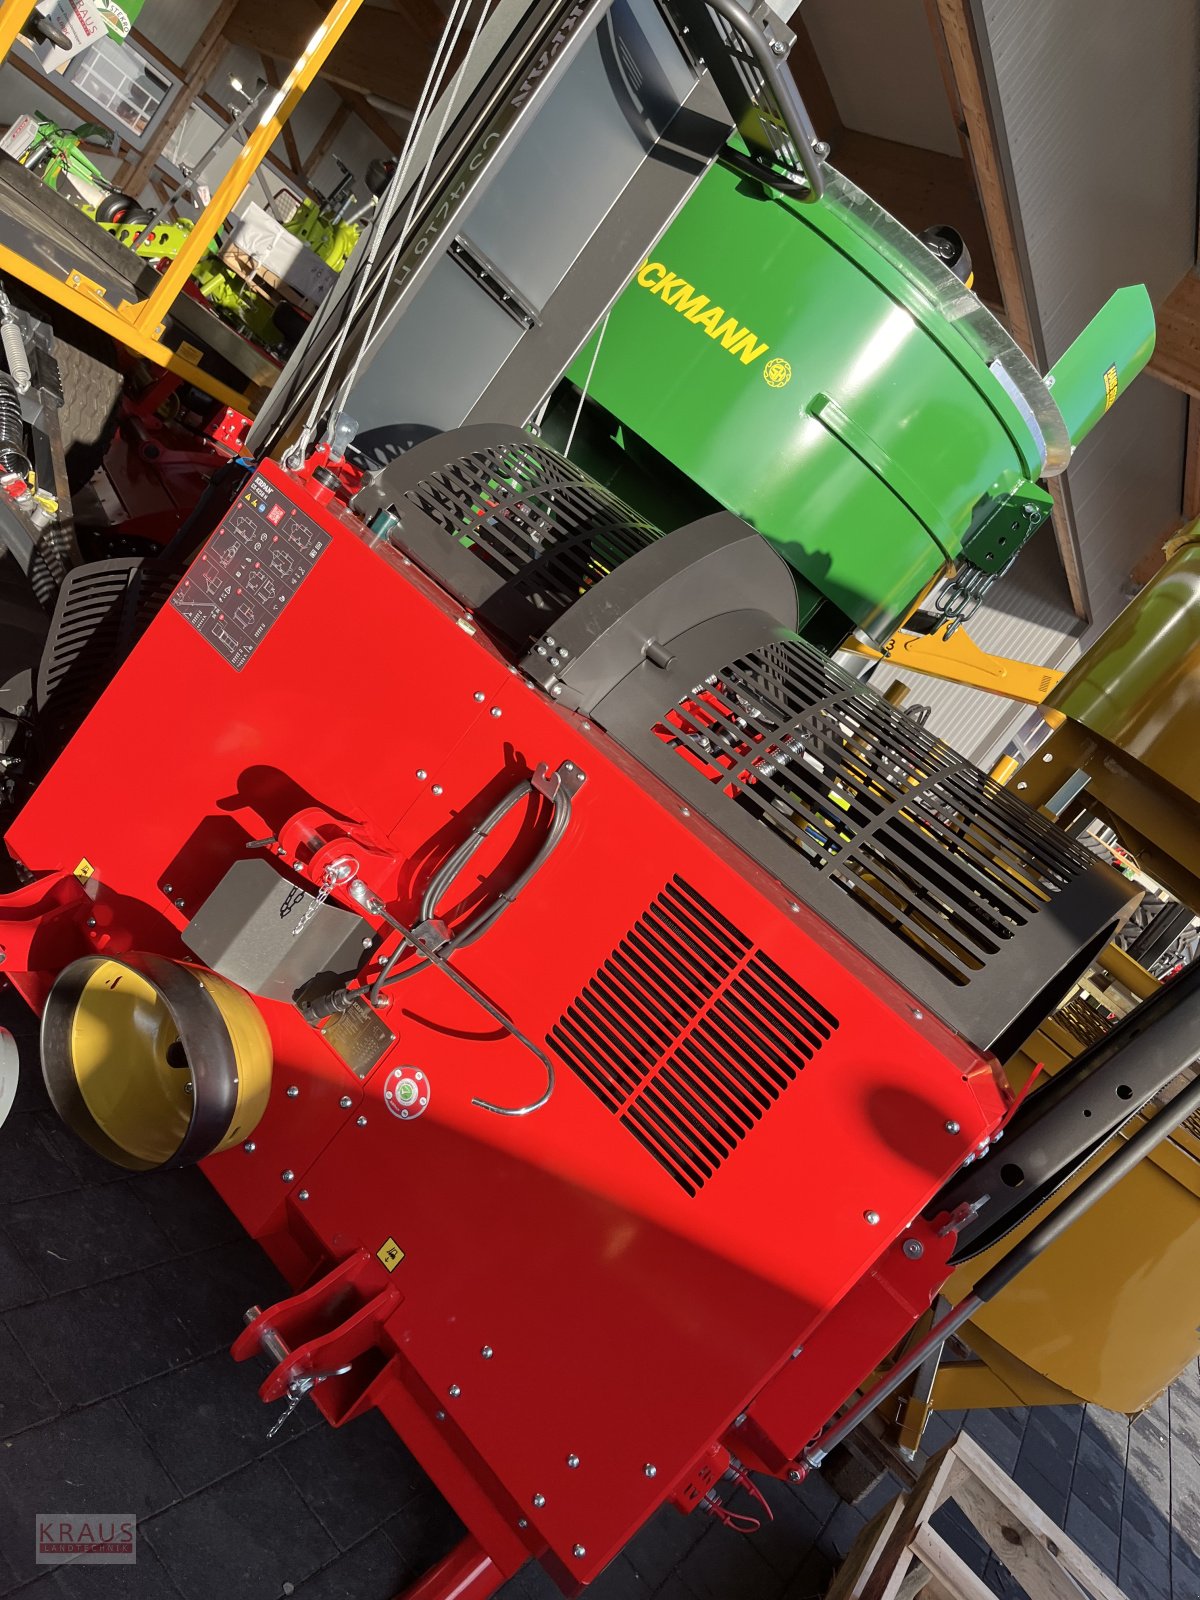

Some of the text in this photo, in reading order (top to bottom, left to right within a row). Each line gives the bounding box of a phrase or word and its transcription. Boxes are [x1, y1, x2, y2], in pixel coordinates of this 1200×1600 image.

[110, 5, 130, 33] STEKRO
[511, 0, 585, 107] RPAN
[636, 257, 770, 366] CKMANN
[254, 476, 272, 495] KRPAN
